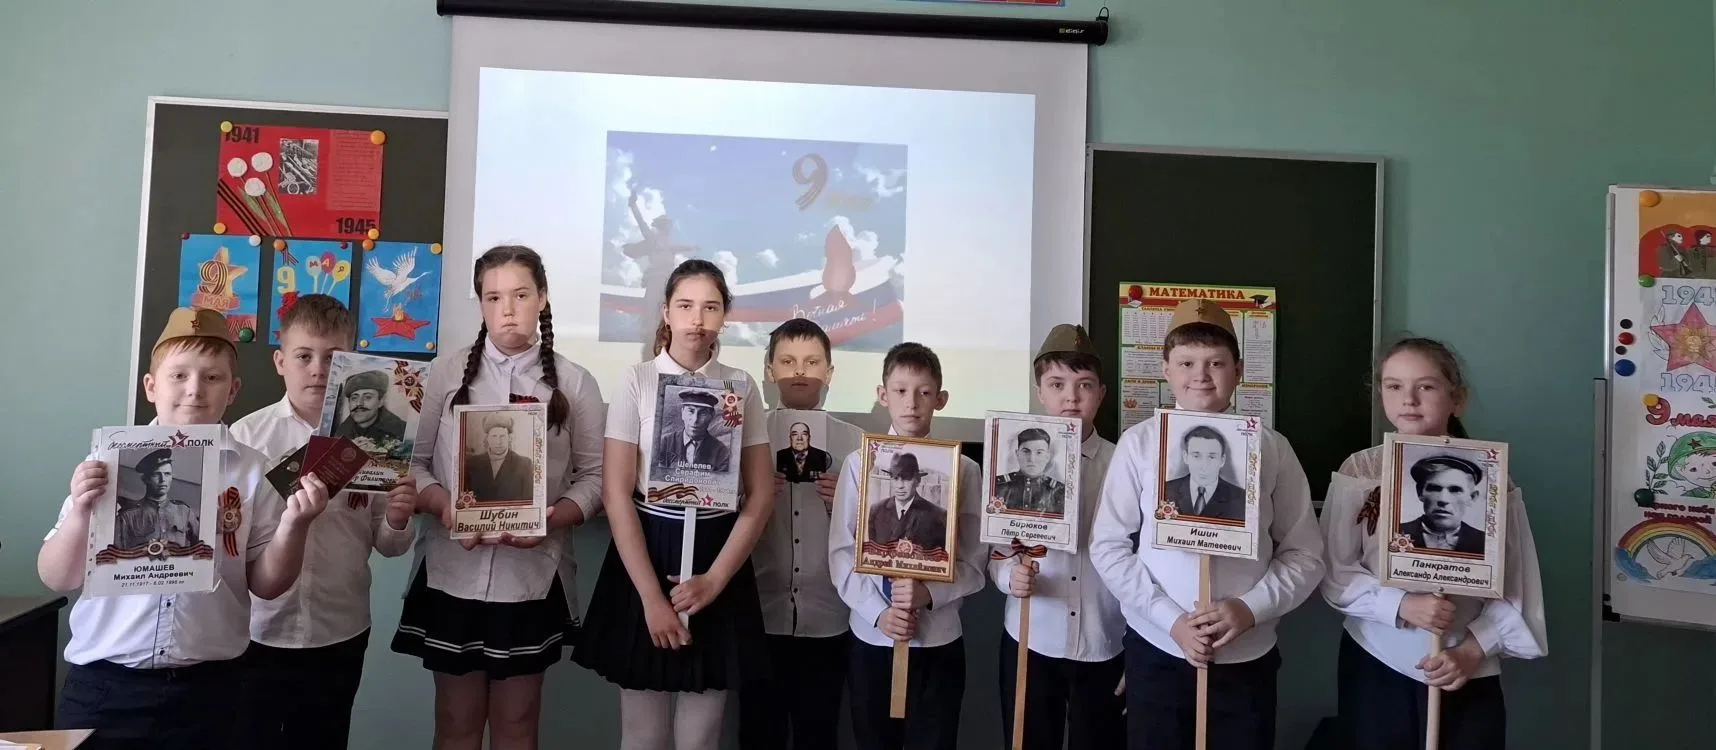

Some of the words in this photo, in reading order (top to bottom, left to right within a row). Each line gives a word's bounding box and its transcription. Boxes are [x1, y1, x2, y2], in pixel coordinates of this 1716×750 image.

[225, 126, 260, 144] 1941
[792, 152, 828, 212] 9
[276, 265, 297, 294] 9
[1149, 287, 1246, 300] МАТЕМАТИКА
[1661, 284, 1716, 307] 194
[203, 296, 232, 309] МАЯ
[1645, 397, 1671, 426] 9
[187, 438, 214, 447] ПОЛК
[675, 468, 711, 478] Серафим
[480, 510, 519, 522] Шубин
[457, 521, 496, 533] Василий
[498, 520, 540, 531] Никитич
[1009, 519, 1049, 531] Бирюков
[1020, 530, 1057, 541] Сергеевич
[1190, 527, 1219, 538] Ишин
[1167, 536, 1197, 547] Михаил
[1197, 540, 1243, 552] Матвеевич
[133, 564, 176, 572] ЮМАШЕВ
[1411, 559, 1472, 573] Панкратов
[113, 573, 147, 582] Михаил
[147, 570, 195, 580] Андреевич
[1393, 568, 1432, 581] Александр
[1432, 573, 1490, 586] Александрович
